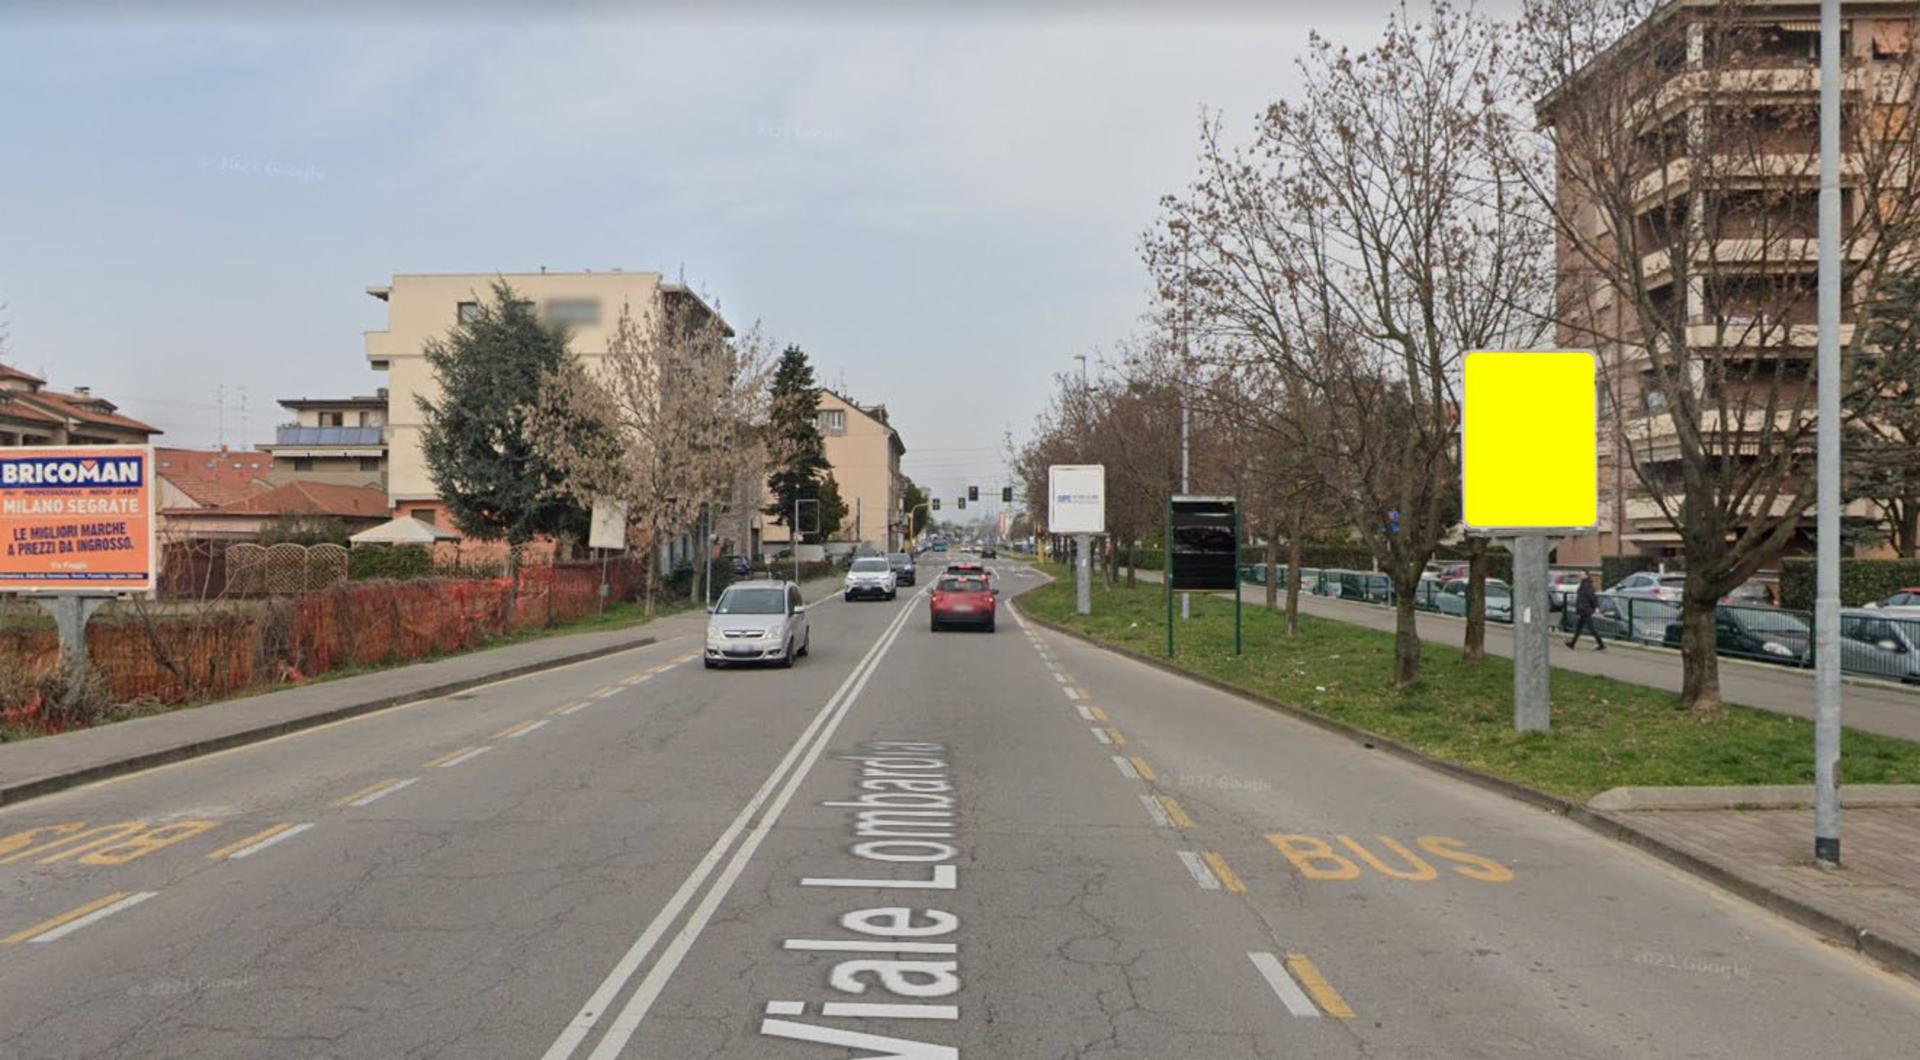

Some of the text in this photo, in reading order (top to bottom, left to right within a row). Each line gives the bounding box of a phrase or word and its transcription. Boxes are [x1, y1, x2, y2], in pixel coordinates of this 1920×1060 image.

[2, 461, 139, 484] BRICOMAN
[3, 498, 139, 514] MILANO SEGRATE
[13, 522, 127, 541] LE MIGLIORI MARCHE
[7, 536, 135, 556] A PREZZI DA INGROSSO.
[1265, 833, 1515, 882] BUS
